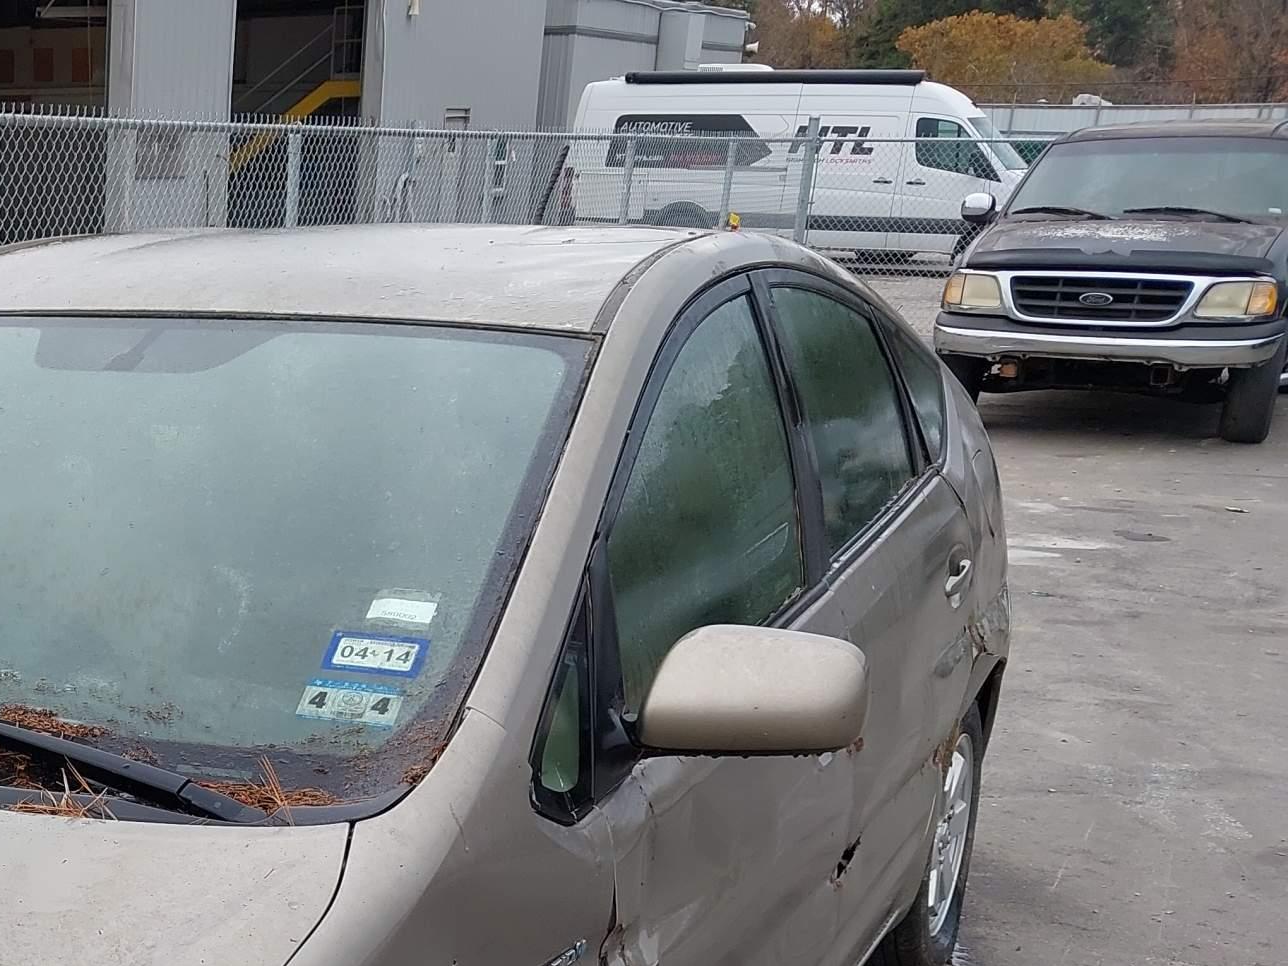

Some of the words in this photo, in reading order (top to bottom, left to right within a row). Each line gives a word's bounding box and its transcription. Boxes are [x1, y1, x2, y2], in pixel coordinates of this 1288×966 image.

[620, 121, 693, 133] AUTOMOTIVE
[340, 645, 369, 660] 04
[383, 648, 411, 664] 14
[308, 691, 328, 709] 4
[370, 697, 391, 715] 4
